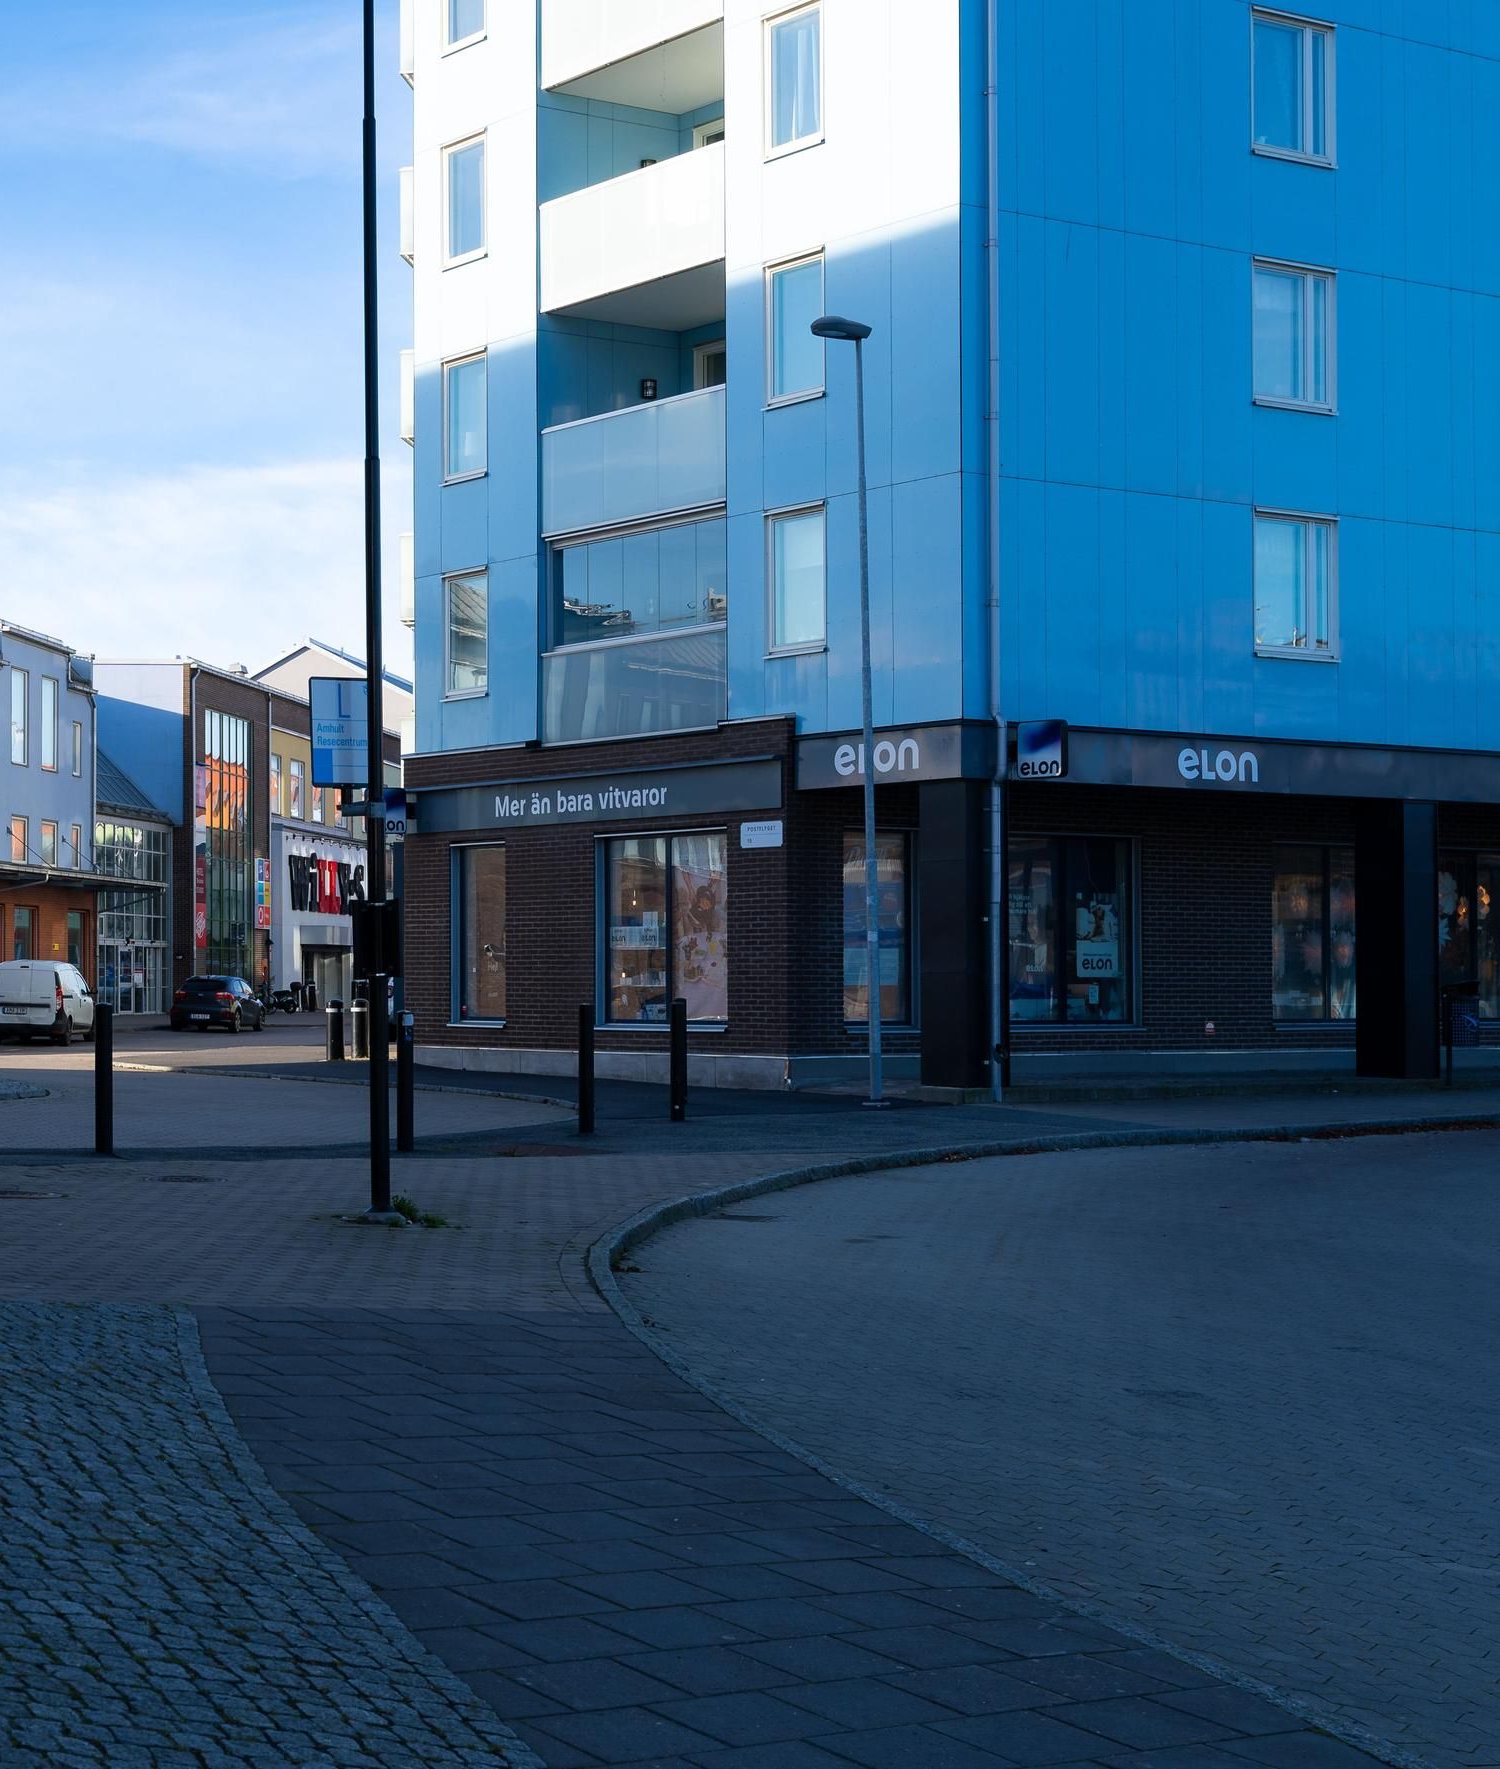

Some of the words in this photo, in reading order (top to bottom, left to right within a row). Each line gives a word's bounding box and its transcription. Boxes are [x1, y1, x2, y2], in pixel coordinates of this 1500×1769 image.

[316, 723, 344, 734] Amhult
[316, 735, 368, 747] Resecentrum
[494, 795, 526, 818] Mer
[531, 792, 551, 815] än
[557, 790, 593, 813] bara
[598, 785, 668, 810] vitvaror
